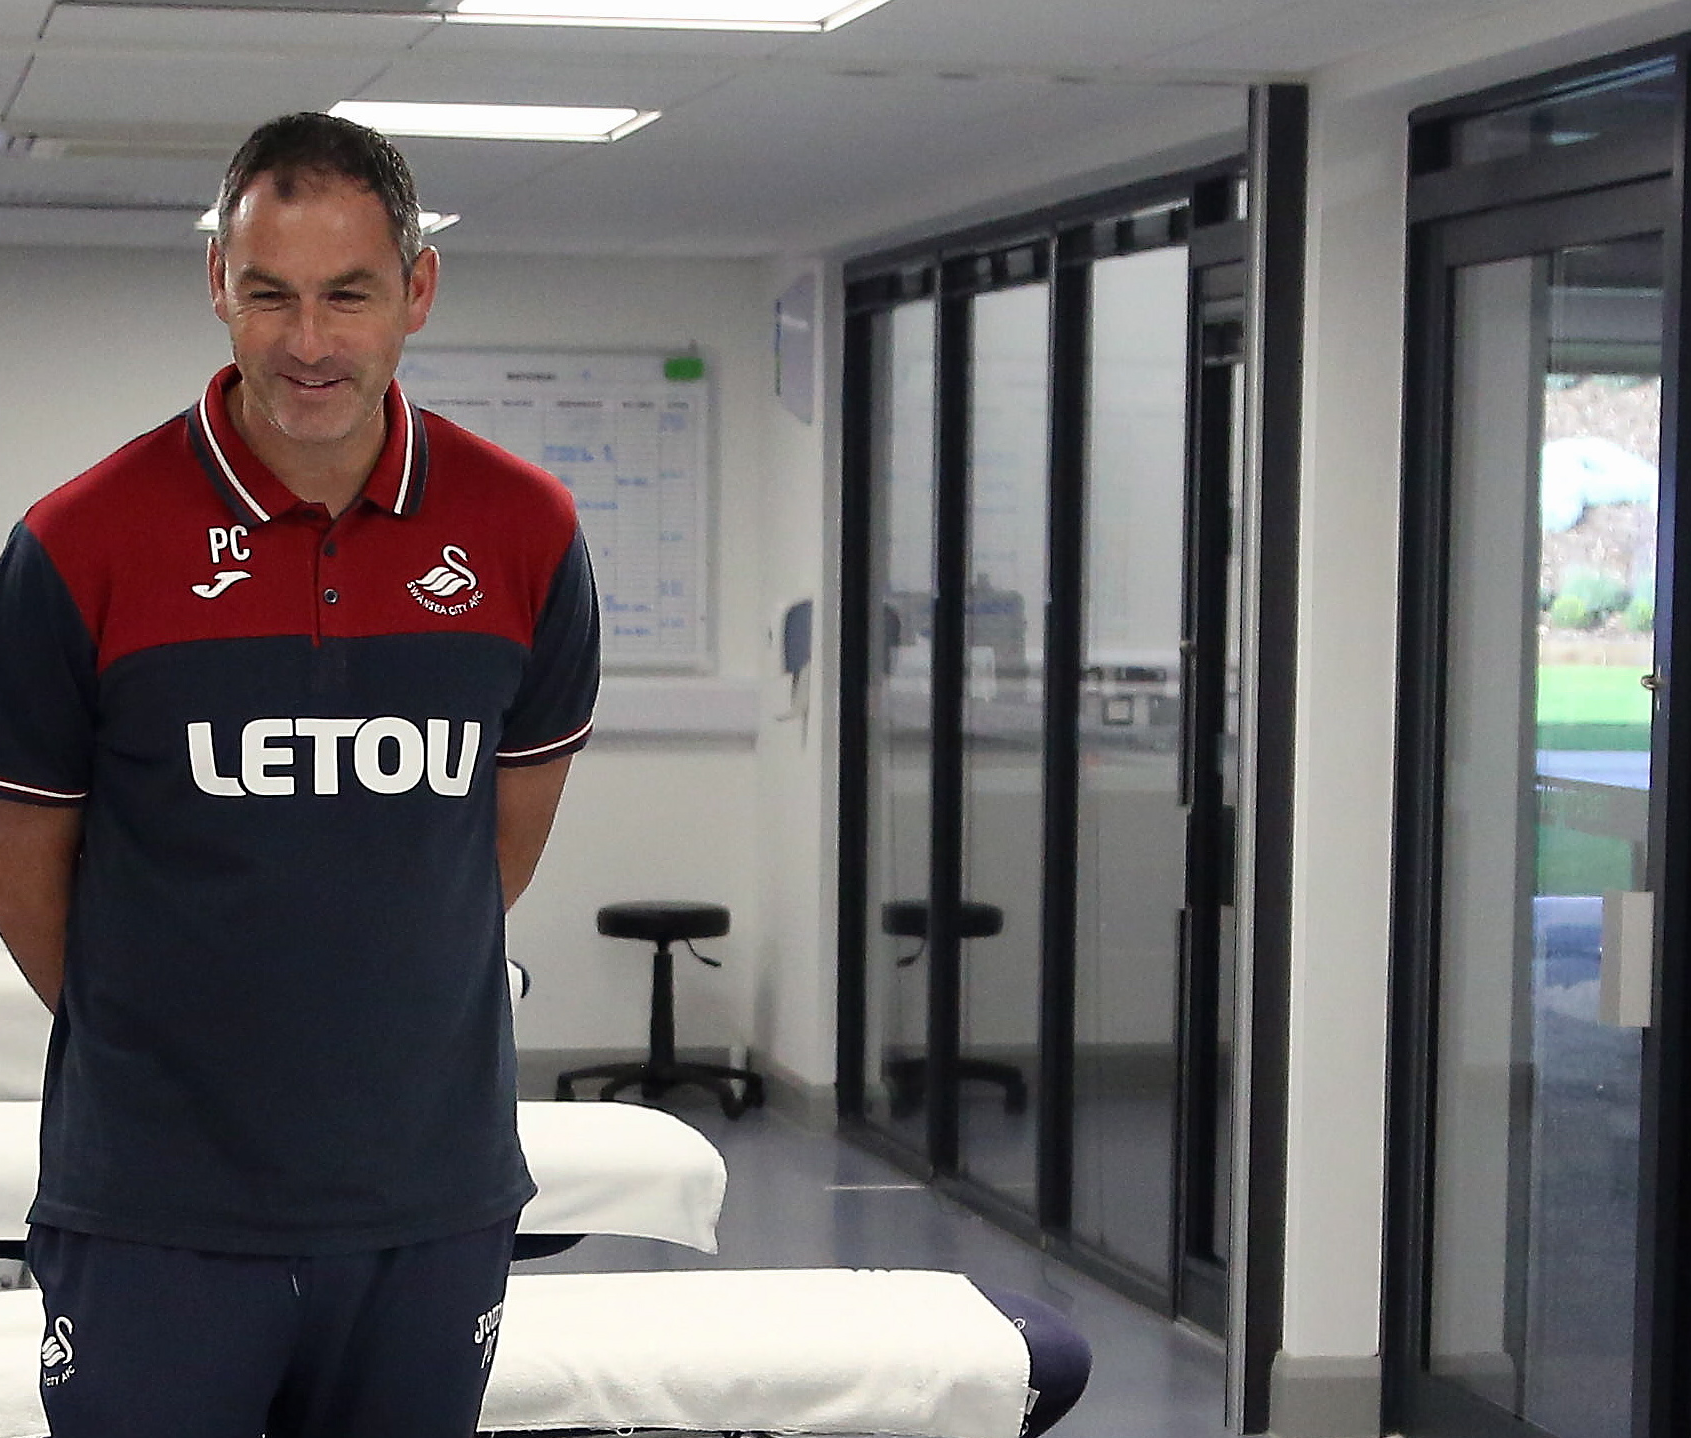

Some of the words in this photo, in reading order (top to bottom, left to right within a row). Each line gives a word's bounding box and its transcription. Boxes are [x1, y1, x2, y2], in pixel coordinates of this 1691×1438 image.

[208, 524, 251, 564] PC
[407, 581, 447, 615] SWANSEA
[448, 602, 468, 616] CITY
[468, 590, 484, 608] AFC
[187, 716, 481, 797] LETOU
